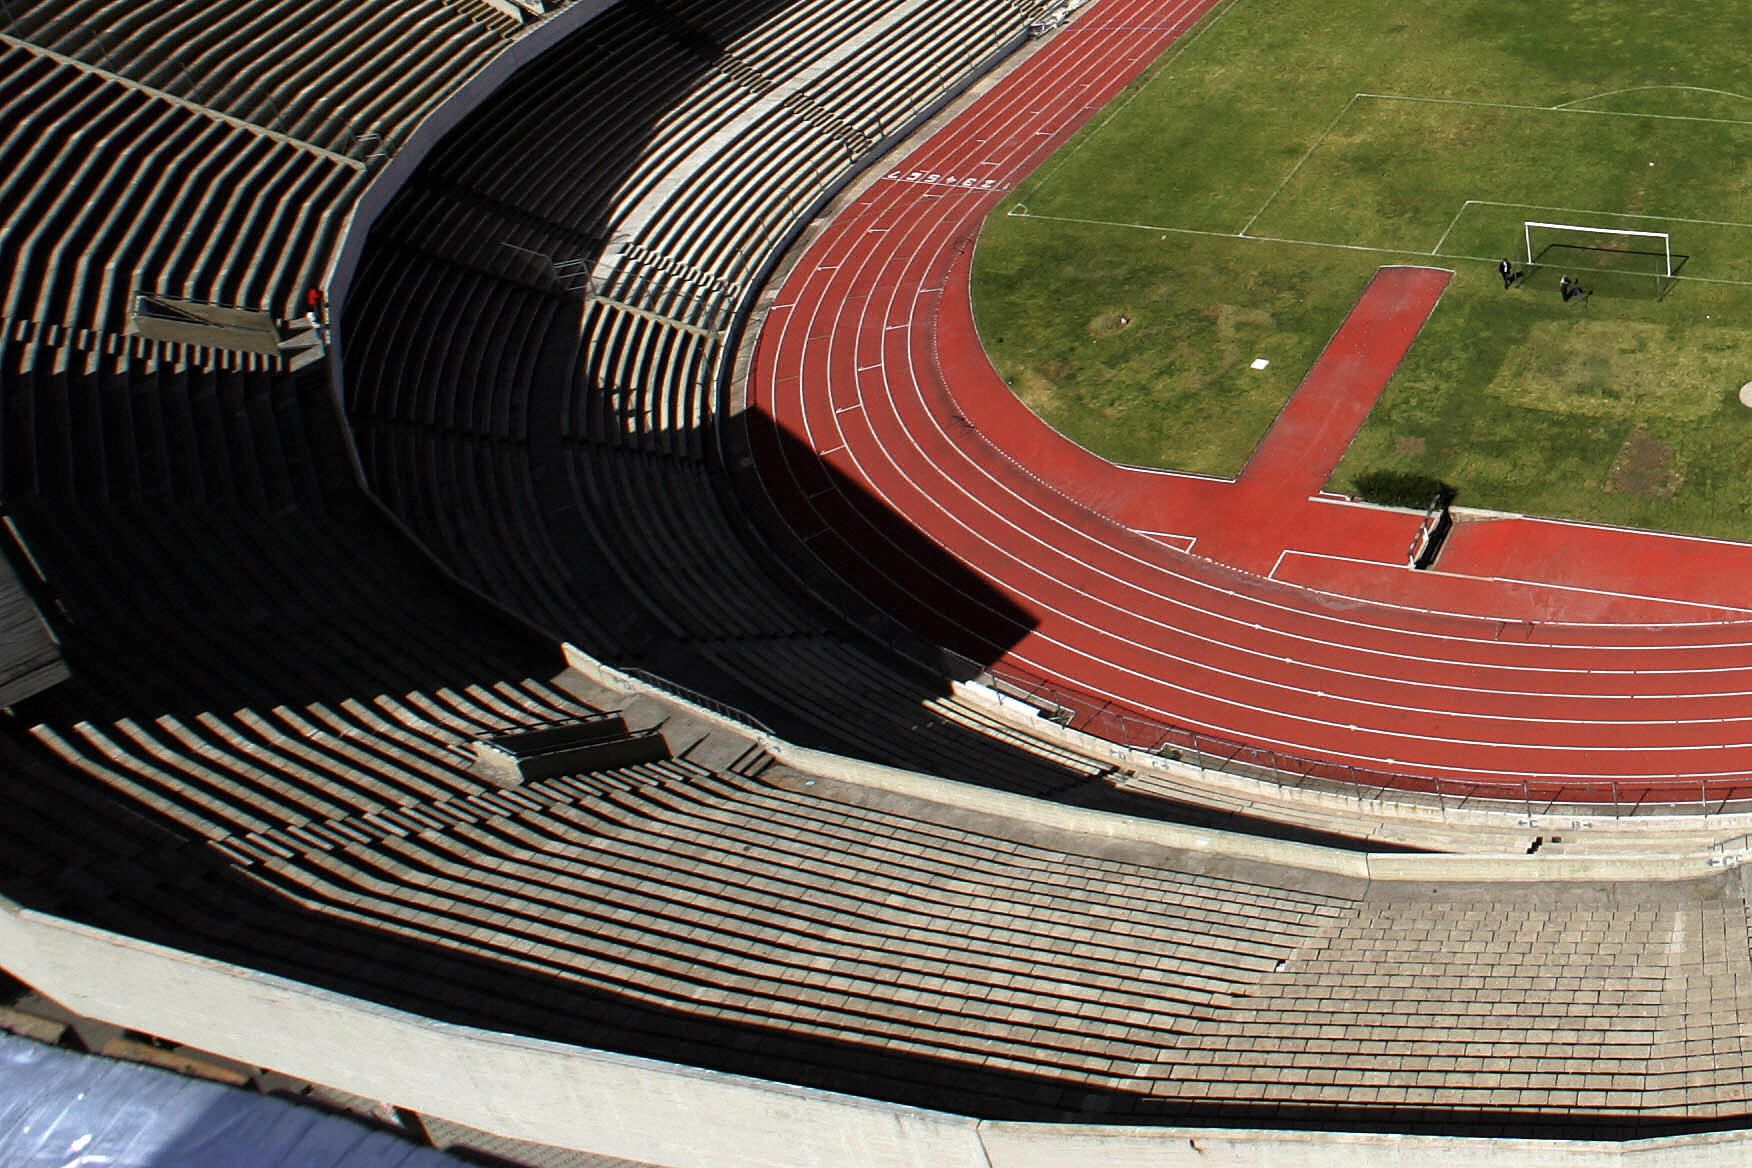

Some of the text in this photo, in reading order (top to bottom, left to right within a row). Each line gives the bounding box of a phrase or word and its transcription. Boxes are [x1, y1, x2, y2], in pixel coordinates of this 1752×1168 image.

[887, 171, 900, 179] 7
[924, 174, 940, 183] 5
[946, 175, 957, 184] 4
[962, 178, 977, 186] 3
[981, 179, 996, 188] 2
